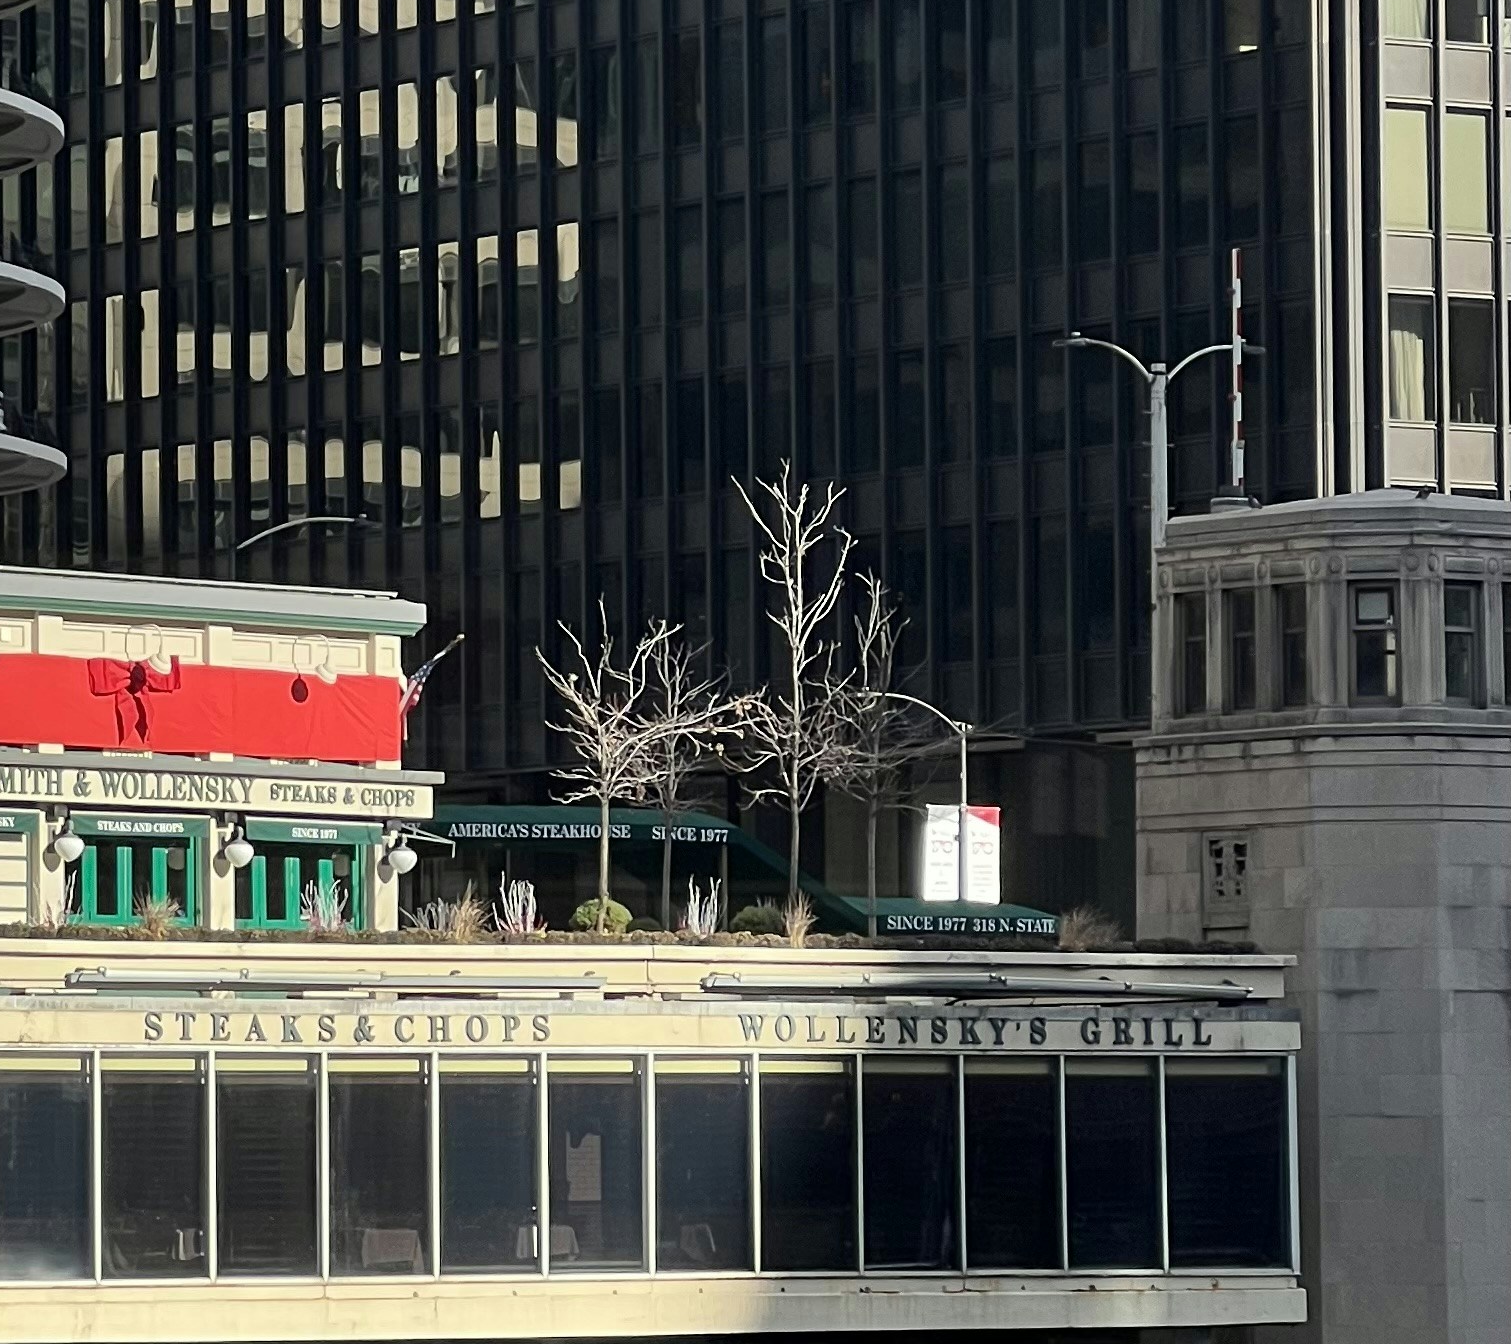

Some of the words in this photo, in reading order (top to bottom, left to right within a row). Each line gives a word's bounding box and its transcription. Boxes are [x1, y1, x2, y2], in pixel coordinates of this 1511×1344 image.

[73, 770, 92, 798] &
[98, 769, 256, 804] WOLLENSKY
[270, 783, 337, 804] STEAKS
[343, 789, 355, 805] &
[361, 787, 414, 807] CHOPS
[97, 820, 131, 832] STEAKS
[133, 821, 153, 833] AND
[154, 822, 184, 833] CHOPS
[292, 827, 319, 839] SINCE
[319, 828, 338, 840] 1977
[448, 823, 529, 838] AMERICA'S
[700, 828, 729, 843] 1977
[887, 915, 934, 931] SINCE
[938, 917, 968, 932] 1977
[972, 918, 996, 933] 318
[999, 918, 1014, 933] N.
[1016, 918, 1056, 933] STATE
[737, 1013, 1049, 1046] WOLLENSKY'S
[1080, 1015, 1214, 1047] GRILL
